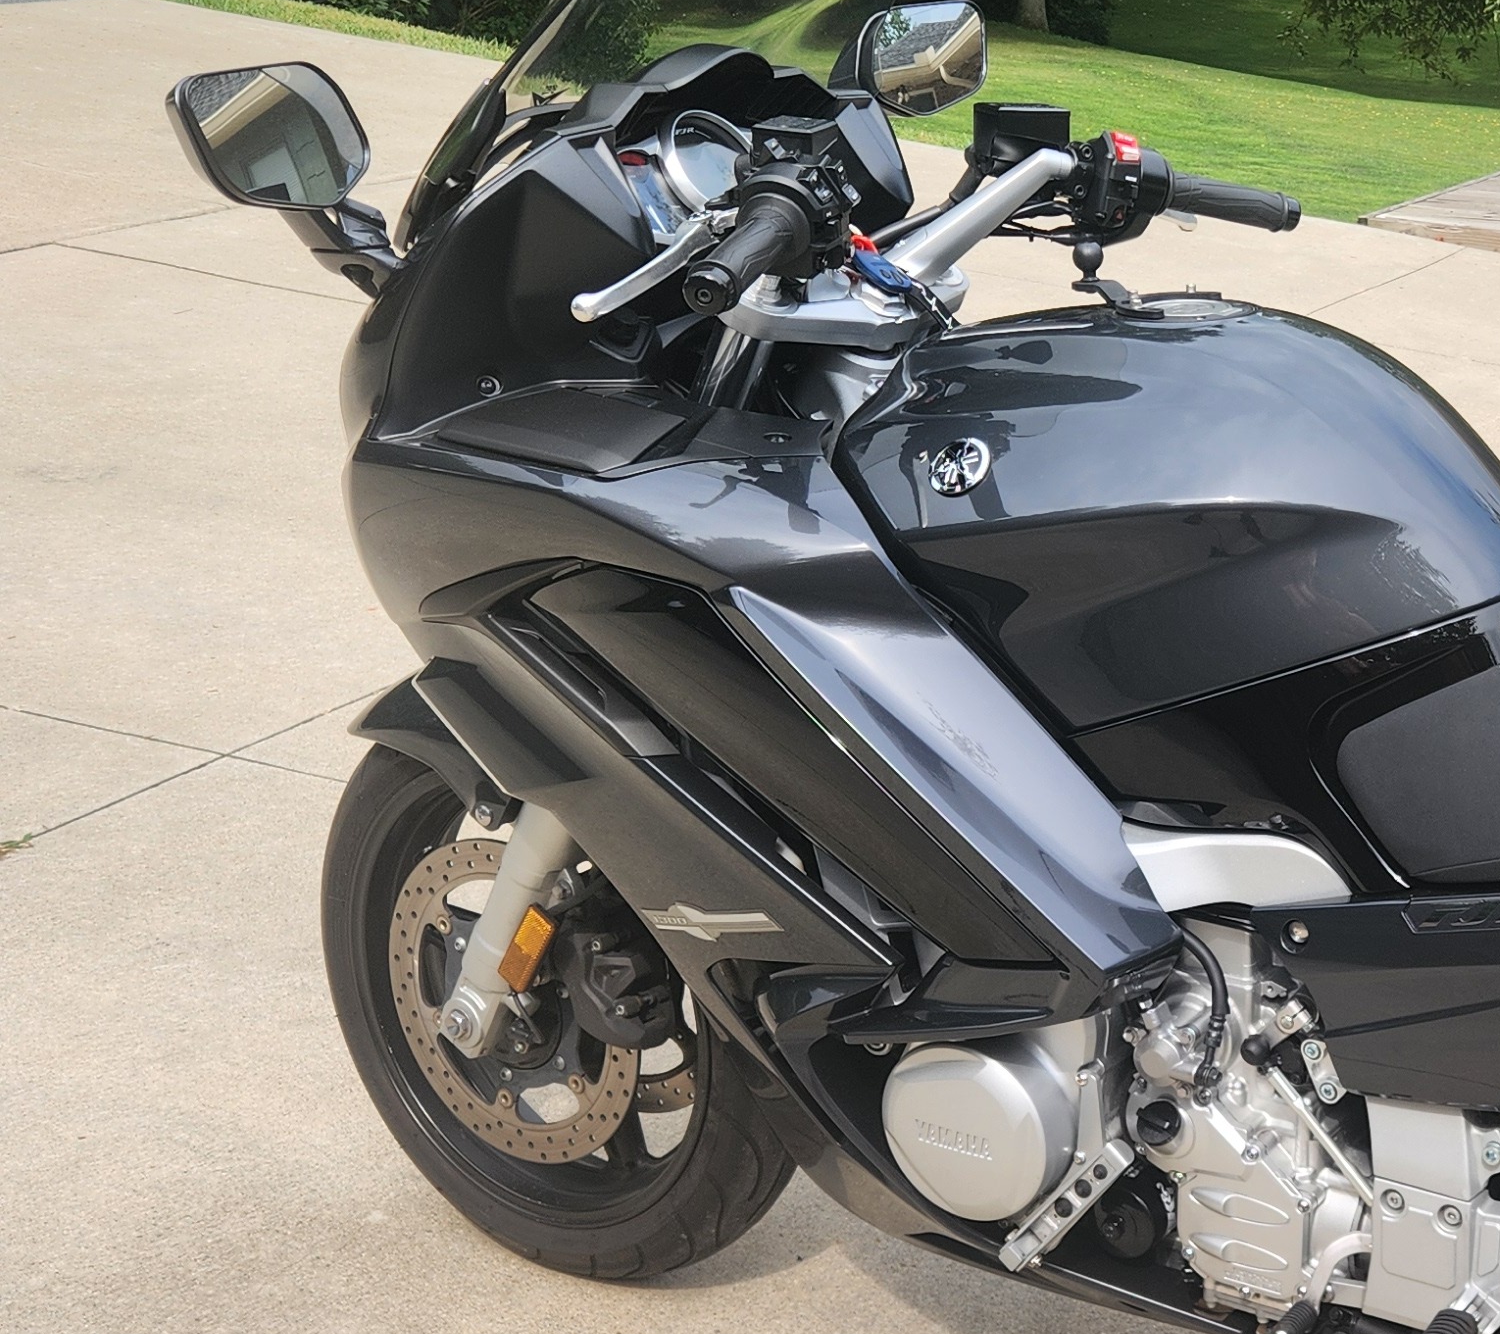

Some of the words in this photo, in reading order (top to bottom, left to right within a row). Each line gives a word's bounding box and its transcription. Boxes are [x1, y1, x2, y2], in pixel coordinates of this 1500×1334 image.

[675, 127, 694, 135] FJR
[653, 915, 687, 924] 1300
[915, 1119, 992, 1160] YAMAHA
